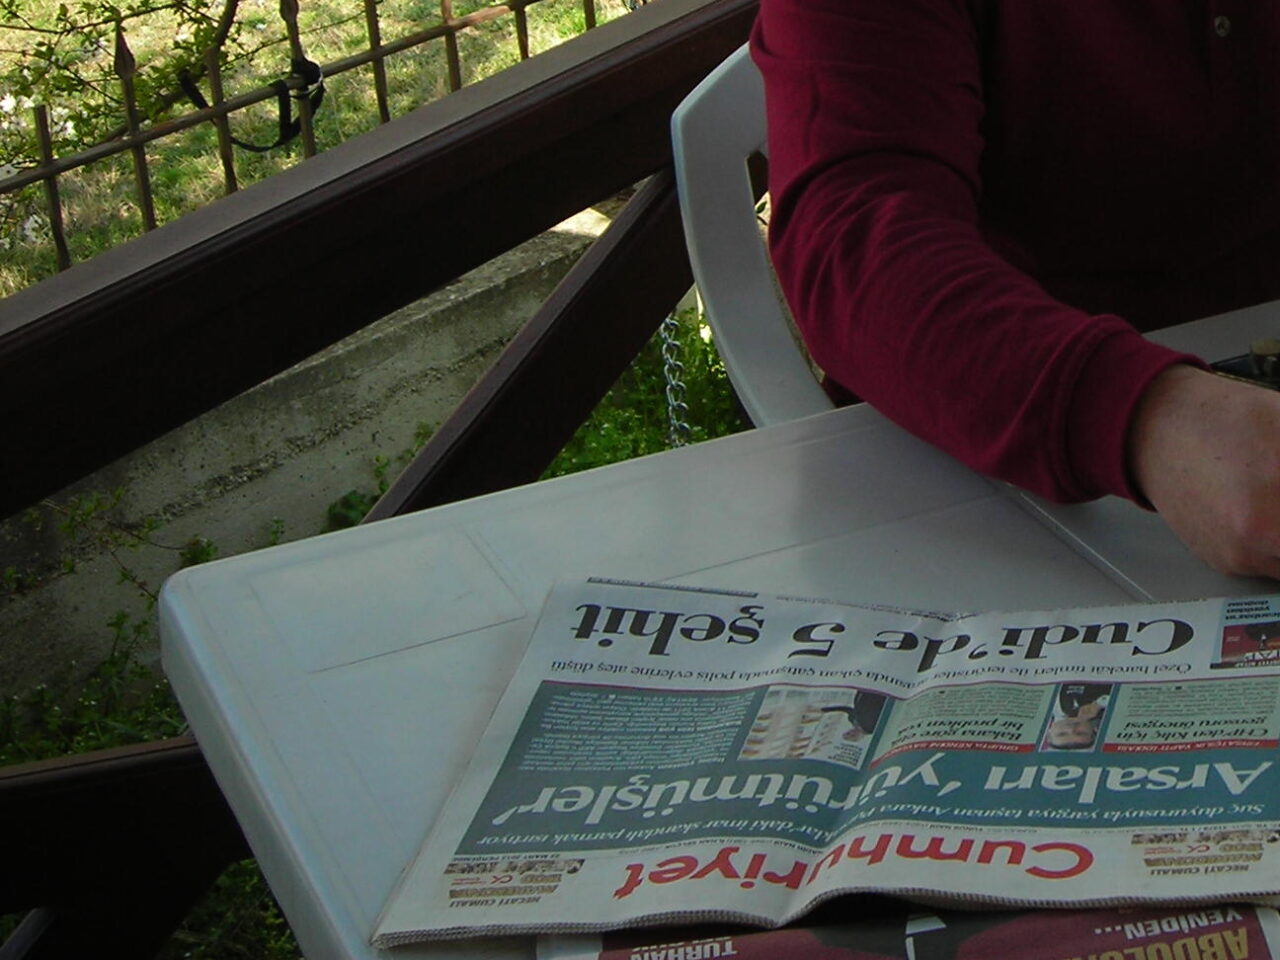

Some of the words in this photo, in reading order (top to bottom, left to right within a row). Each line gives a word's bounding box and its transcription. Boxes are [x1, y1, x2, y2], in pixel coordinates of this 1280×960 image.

[570, 604, 765, 656] şehit
[787, 622, 846, 659] 5
[550, 660, 595, 673] düştü
[597, 661, 628, 674] ateş
[1008, 666, 1029, 679] ile
[1034, 665, 1087, 679] timleri
[1153, 663, 1193, 675] Özel
[630, 666, 694, 681] evlerine
[696, 671, 736, 683] polis
[819, 668, 862, 679] çıkan
[984, 761, 1274, 804] Arsaları
[1027, 808, 1100, 821] yargıya
[1103, 805, 1224, 823] duyurusuyla
[1229, 803, 1265, 816] Suç
[703, 819, 748, 830] imar
[553, 828, 625, 845] parmak
[612, 834, 1095, 901] Cumhuriyet
